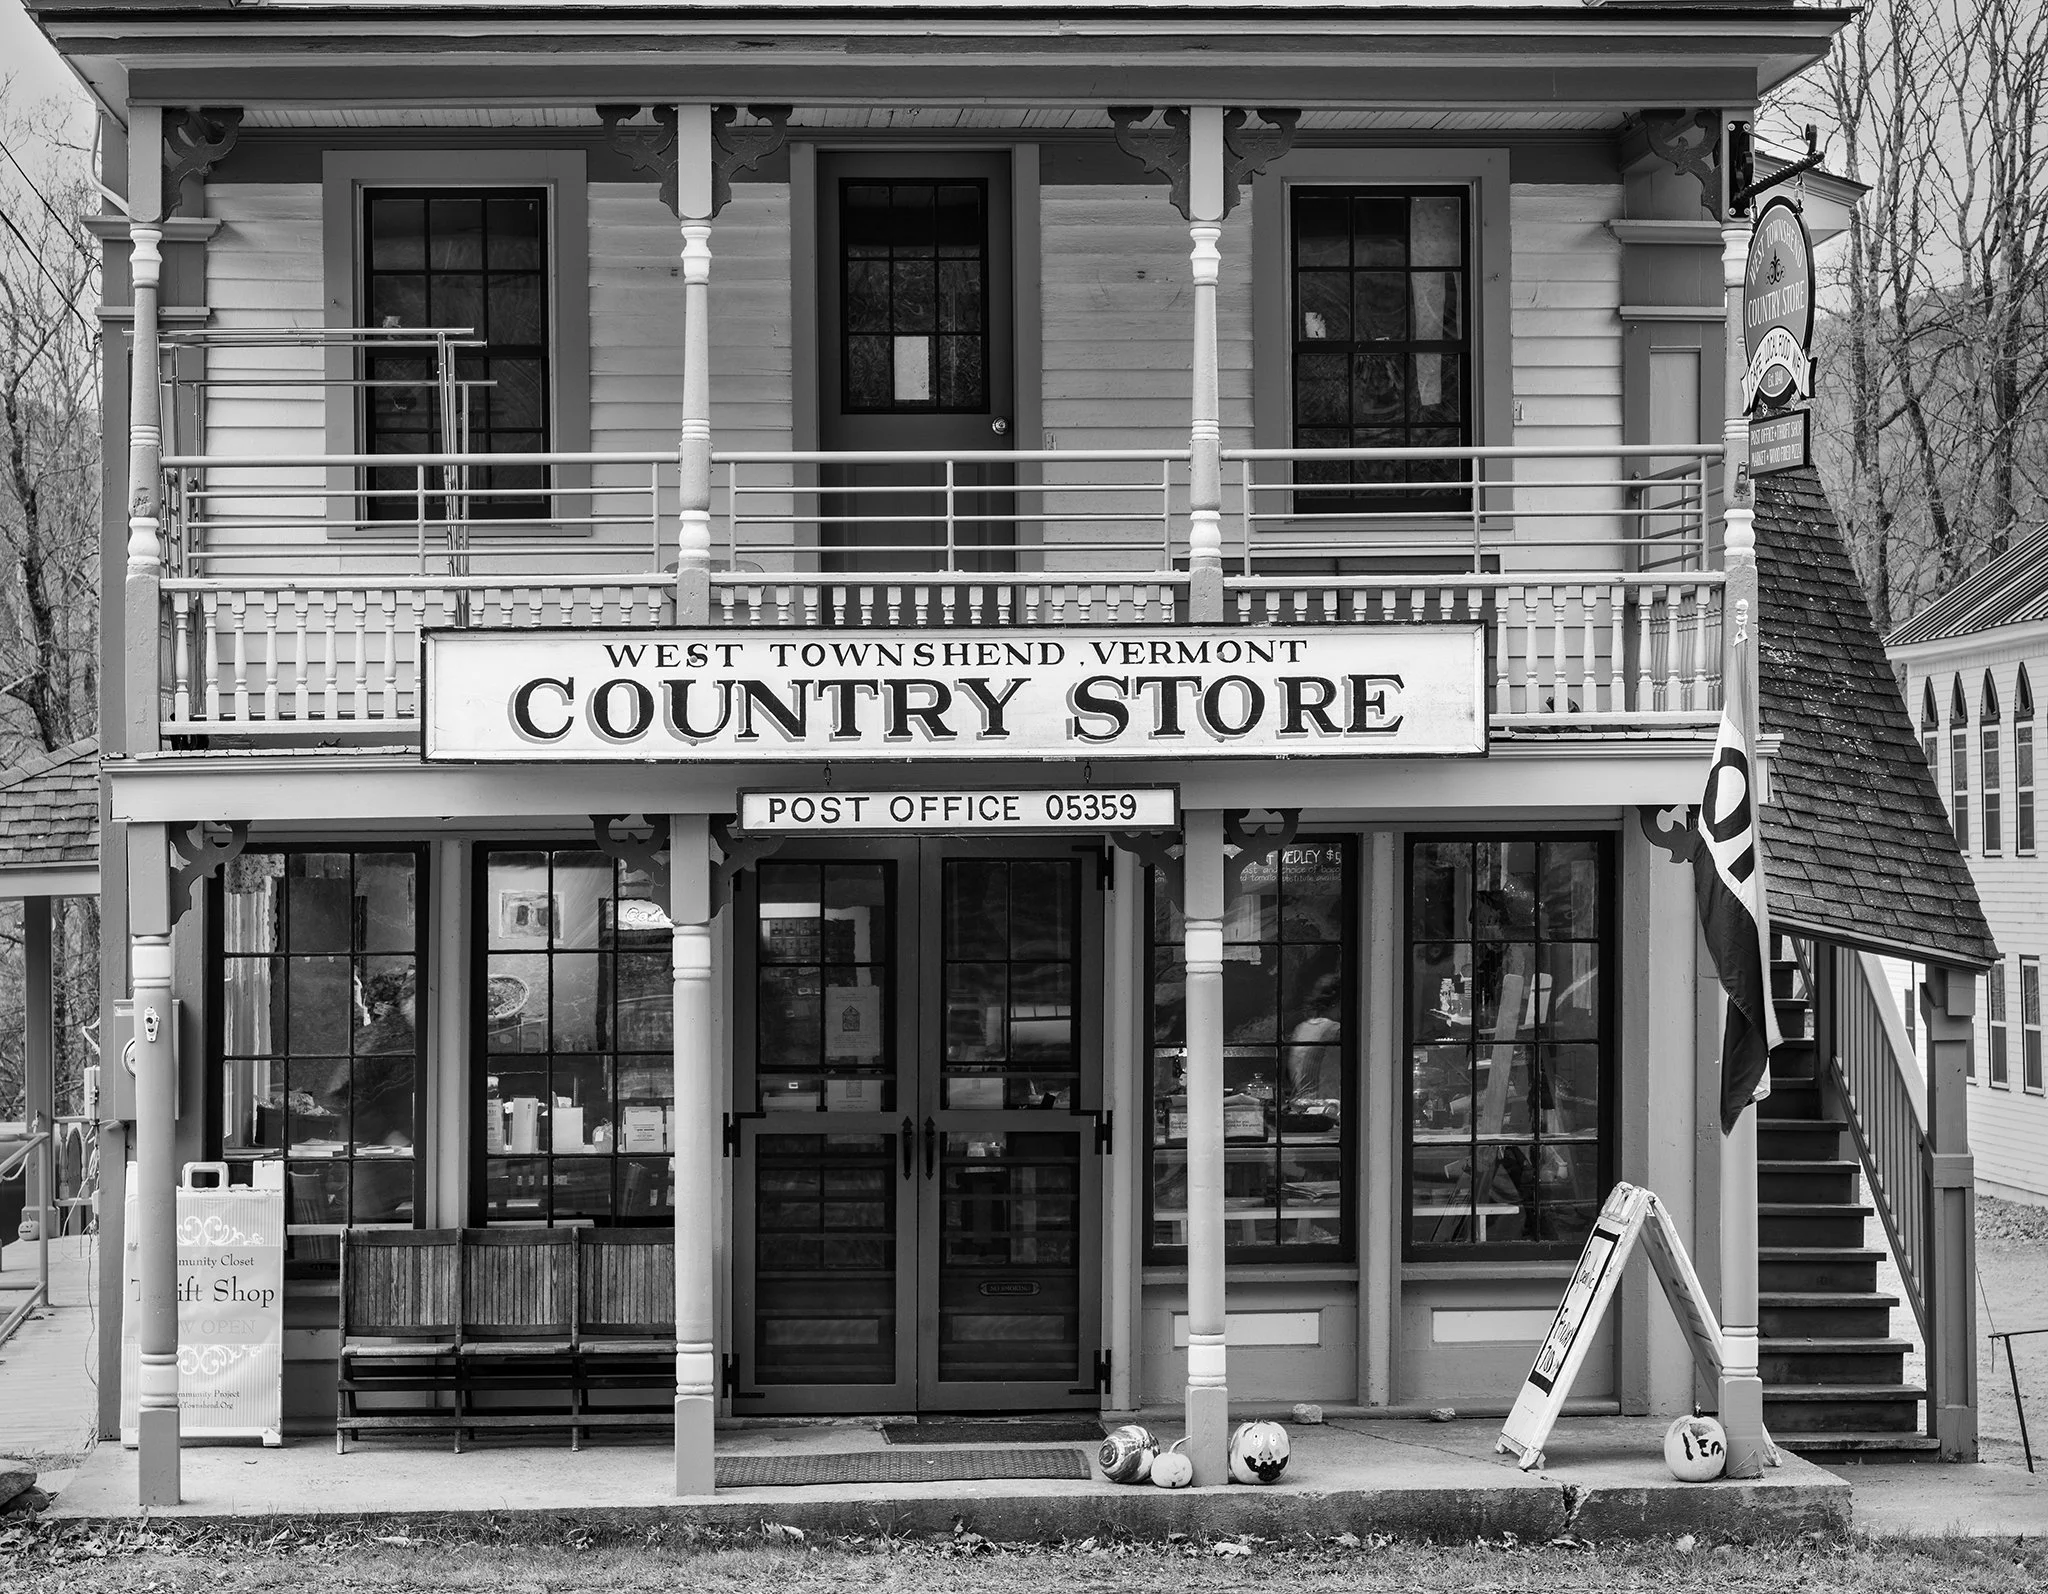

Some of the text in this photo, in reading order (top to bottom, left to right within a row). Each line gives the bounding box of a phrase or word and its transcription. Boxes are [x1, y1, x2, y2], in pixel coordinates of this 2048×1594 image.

[1750, 219, 1803, 285] WEST TOWNSHEND
[1748, 280, 1805, 328] COUNTRY STORE
[603, 643, 744, 668] WEST
[508, 673, 1405, 746] COUNTRY STORE
[769, 793, 1138, 823] POST OFFICE 05359
[178, 1253, 254, 1269] munity Closet
[213, 1276, 275, 1308] Shop
[201, 1319, 256, 1336] OPEN
[213, 1389, 240, 1400] Project
